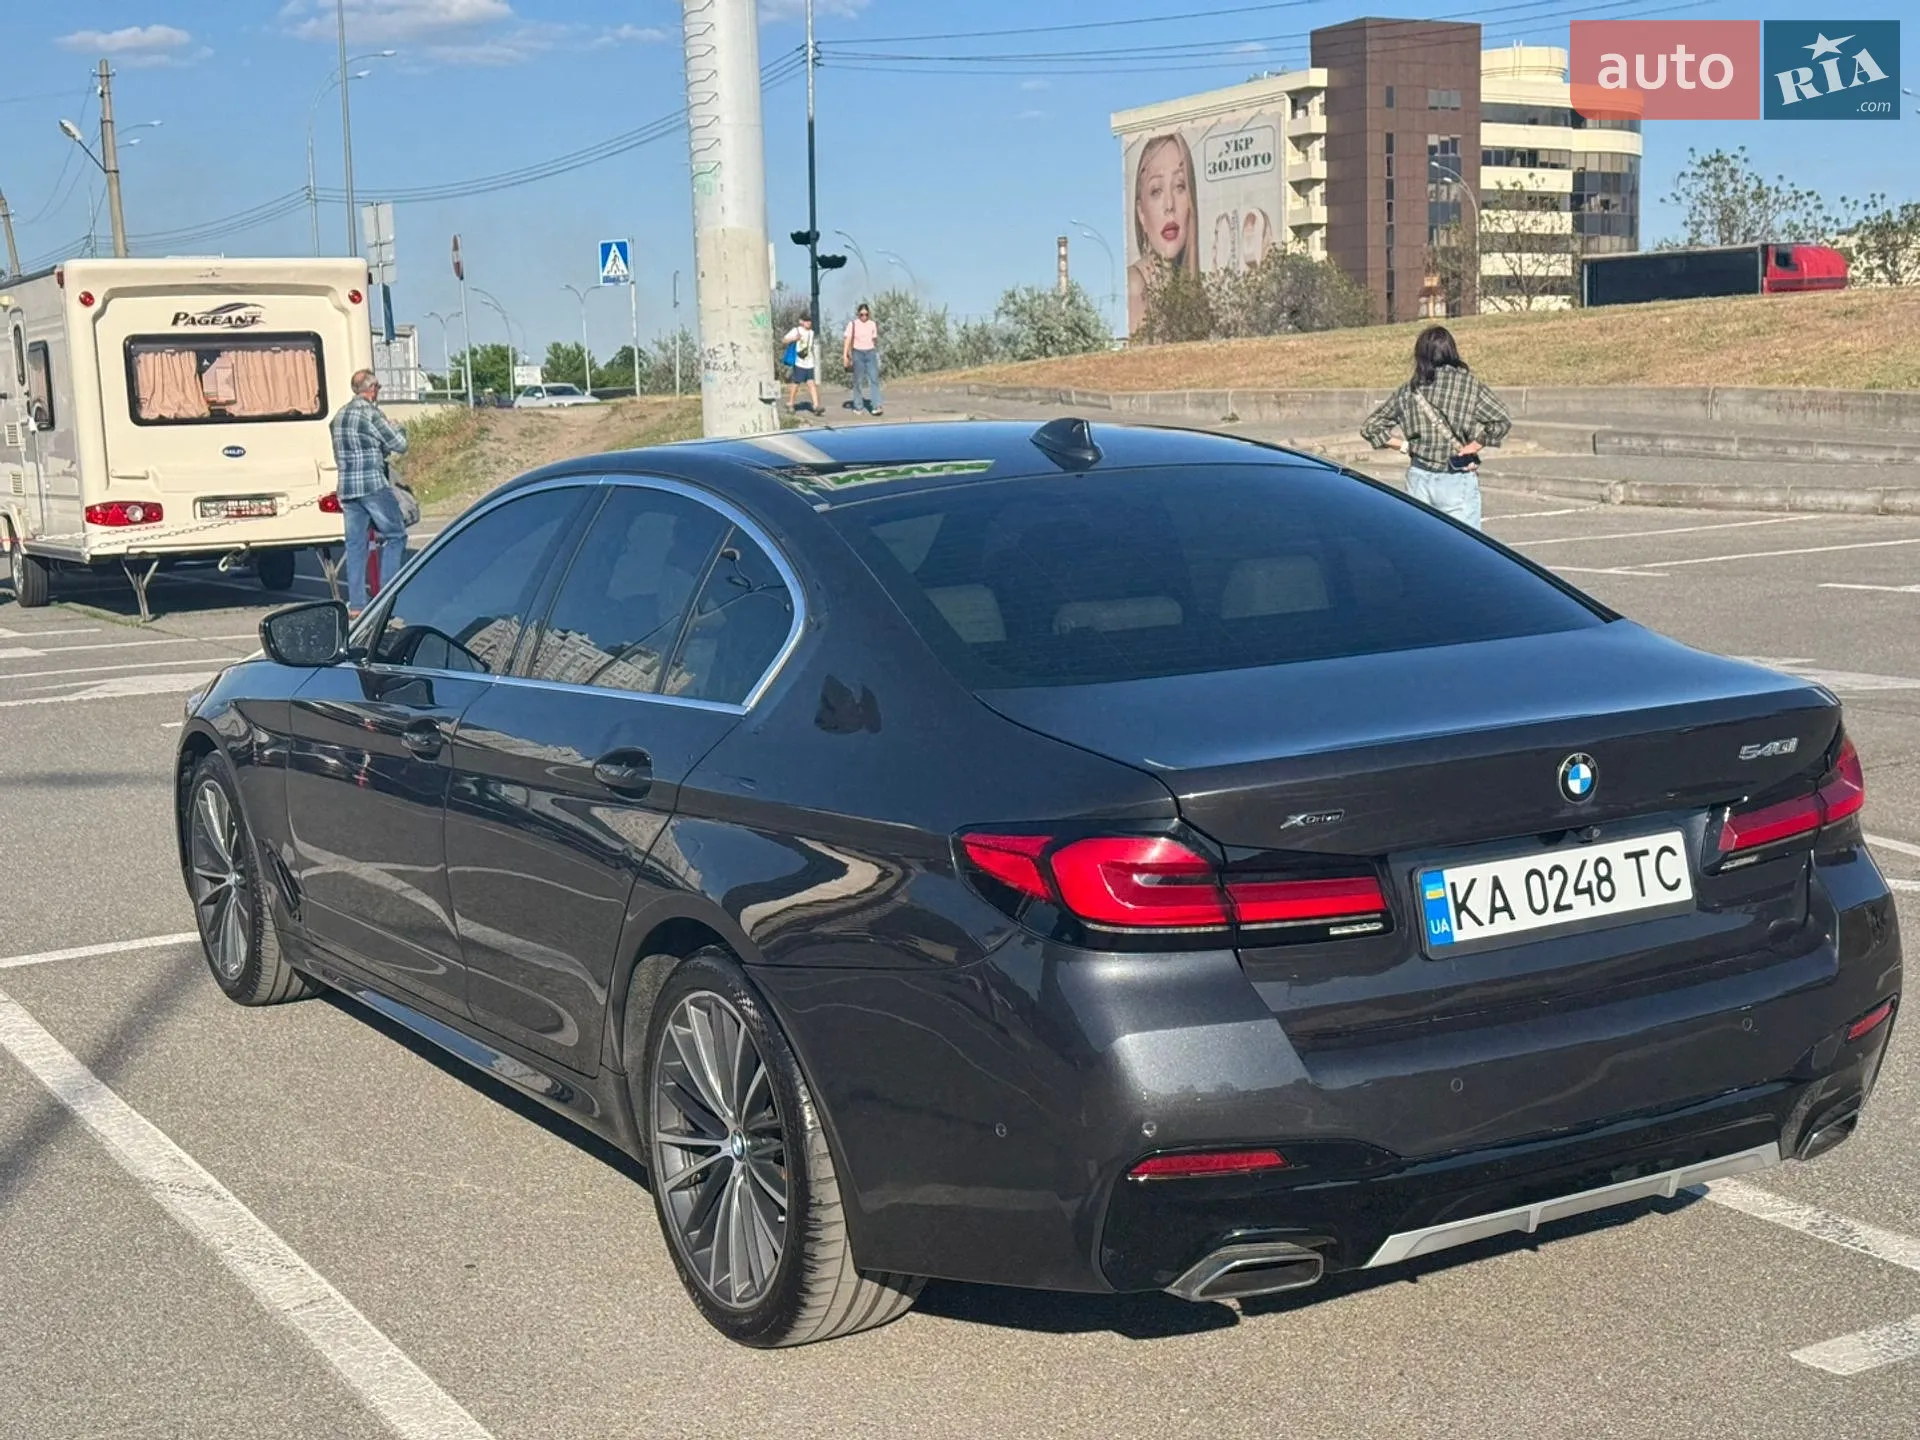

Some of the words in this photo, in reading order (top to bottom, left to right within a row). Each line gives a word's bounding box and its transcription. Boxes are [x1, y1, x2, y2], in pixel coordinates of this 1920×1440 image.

[1225, 136, 1254, 154] УКР
[1208, 152, 1272, 175] ЗОЛОТО
[171, 311, 261, 327] PAGEANT
[1450, 875, 1516, 930] KA
[1525, 857, 1616, 916] 0248
[1624, 845, 1682, 897] TC
[1430, 918, 1451, 935] UA
